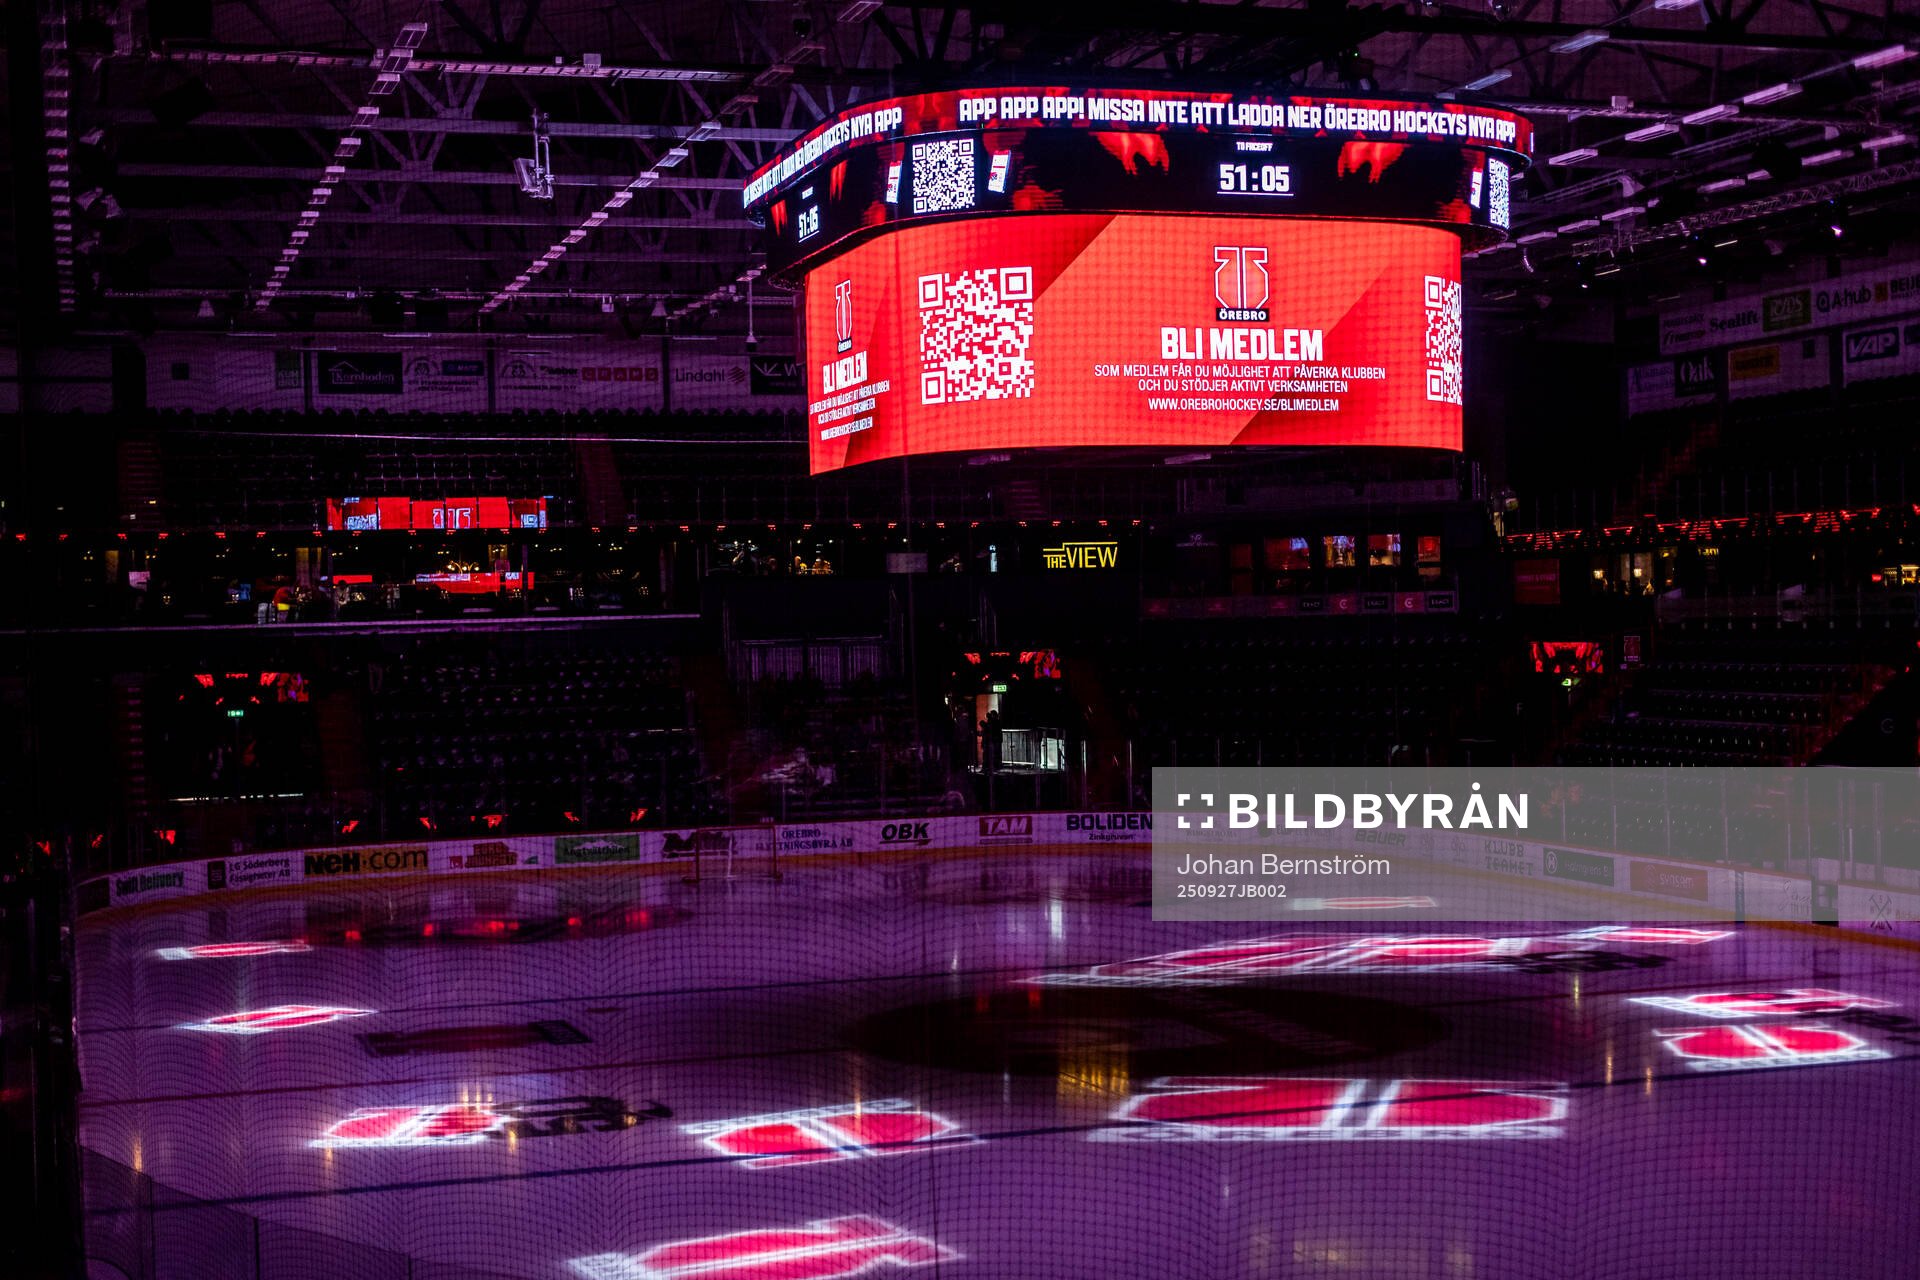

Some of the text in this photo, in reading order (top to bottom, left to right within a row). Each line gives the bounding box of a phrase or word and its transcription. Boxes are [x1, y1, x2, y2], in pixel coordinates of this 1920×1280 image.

[851, 112, 872, 139] NYA
[875, 107, 902, 132] APP
[959, 97, 1516, 143] APP APP APP! MISSA INTE ATT LADDA NER ÖREBRO HOCKEYS NYA APP
[1220, 163, 1290, 192] 51:05
[1219, 308, 1267, 321] ÖREBRO
[1161, 327, 1323, 362] BLI MEDLEM
[1848, 332, 1897, 359] VAP
[675, 368, 725, 382] Lindahl
[1095, 362, 1386, 380] SOM MEDLEM FÅR DU MÖJLIGHET ATT PÅVERKA KLUBBEN
[1138, 377, 1348, 393] OCH DU STÖDJER AKTIVT VERKSAMHETEN
[1148, 398, 1339, 412] WWW.OREBROHOCKEY.SE/BLIMEDLEM
[1043, 546, 1118, 569] THE VIEW
[985, 817, 1028, 834] TAM
[1067, 813, 1154, 830] BOLIDEN
[881, 822, 929, 840] OBK
